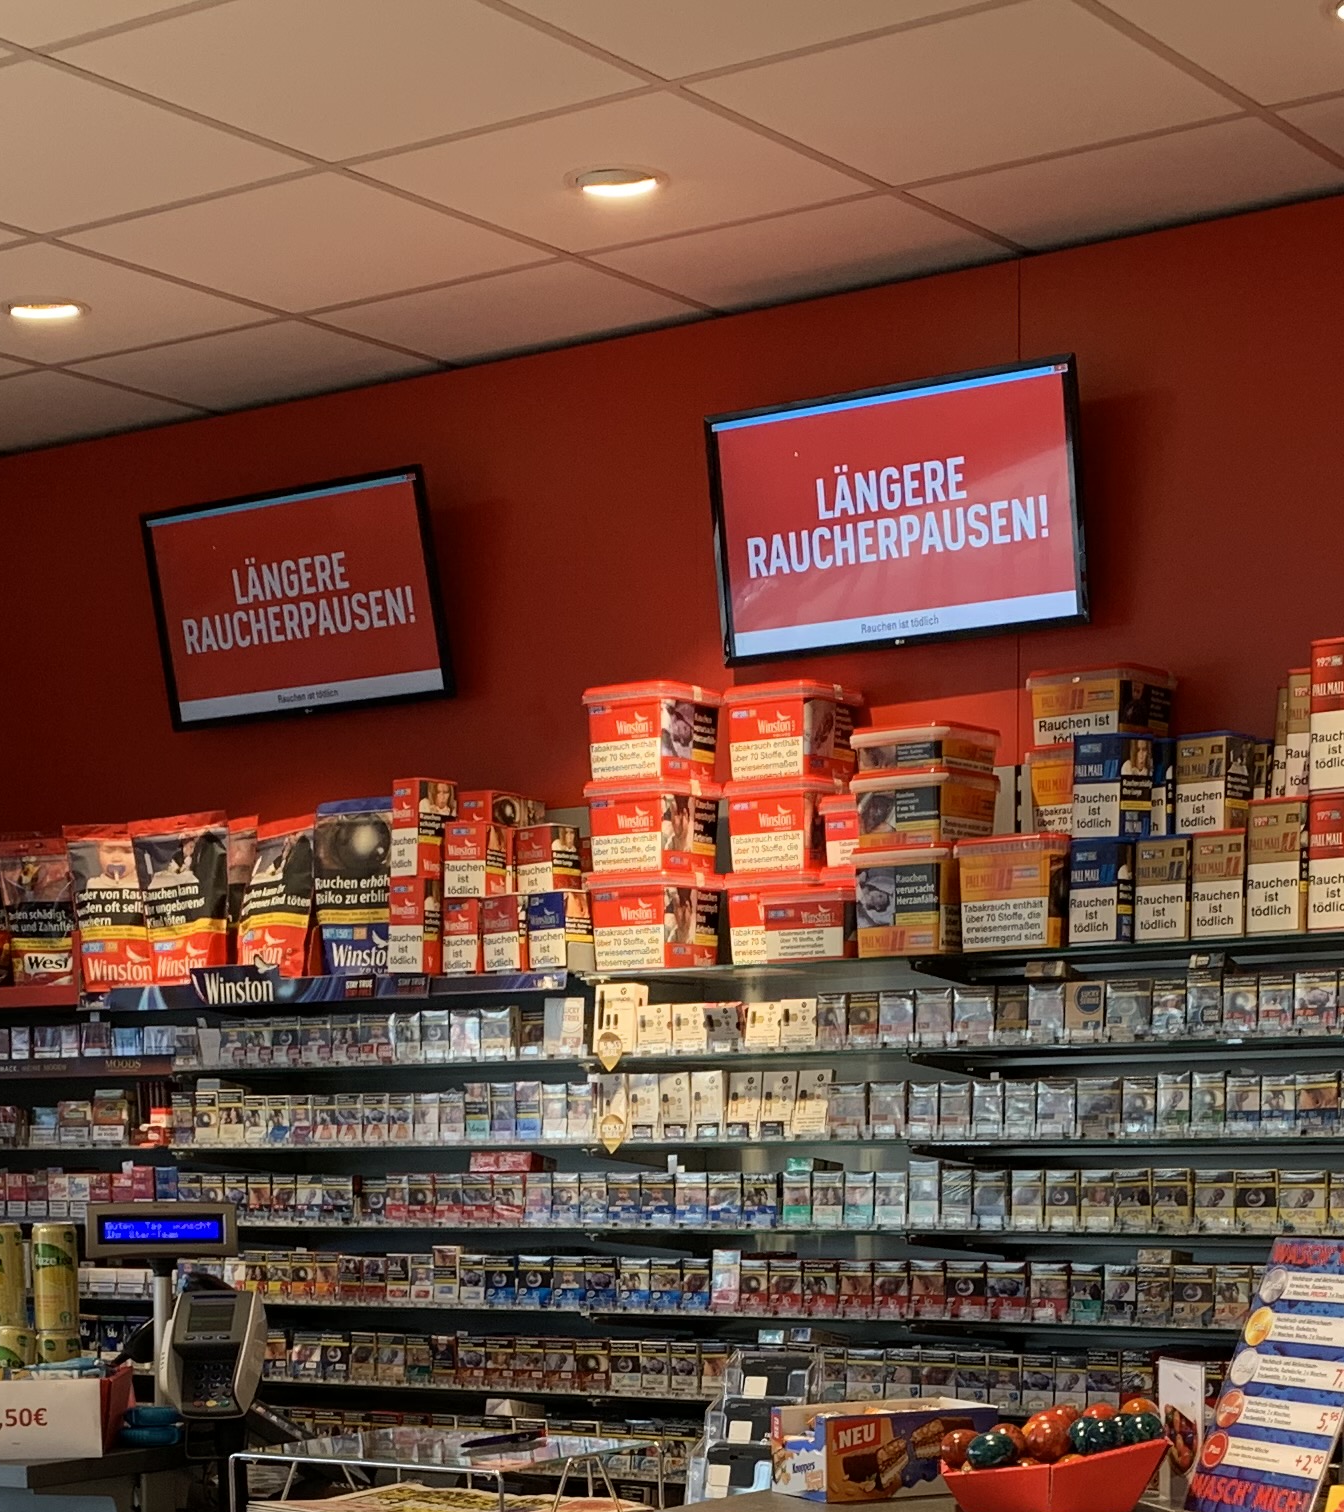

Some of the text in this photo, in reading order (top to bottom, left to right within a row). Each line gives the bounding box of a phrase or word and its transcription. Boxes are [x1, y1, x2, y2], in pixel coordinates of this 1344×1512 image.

[815, 456, 967, 520] LÄNGERE
[746, 495, 1049, 578] RAUCHERPAUSEN!
[232, 551, 349, 604] LÄNGERE
[183, 586, 416, 655] RAUCHERPAUSEN!
[861, 613, 939, 635] Rauchen ist tödlich
[1327, 743, 1342, 756] ist
[88, 958, 153, 982] Winston
[205, 972, 274, 1004] Winston
[838, 1424, 876, 1449] NEU
